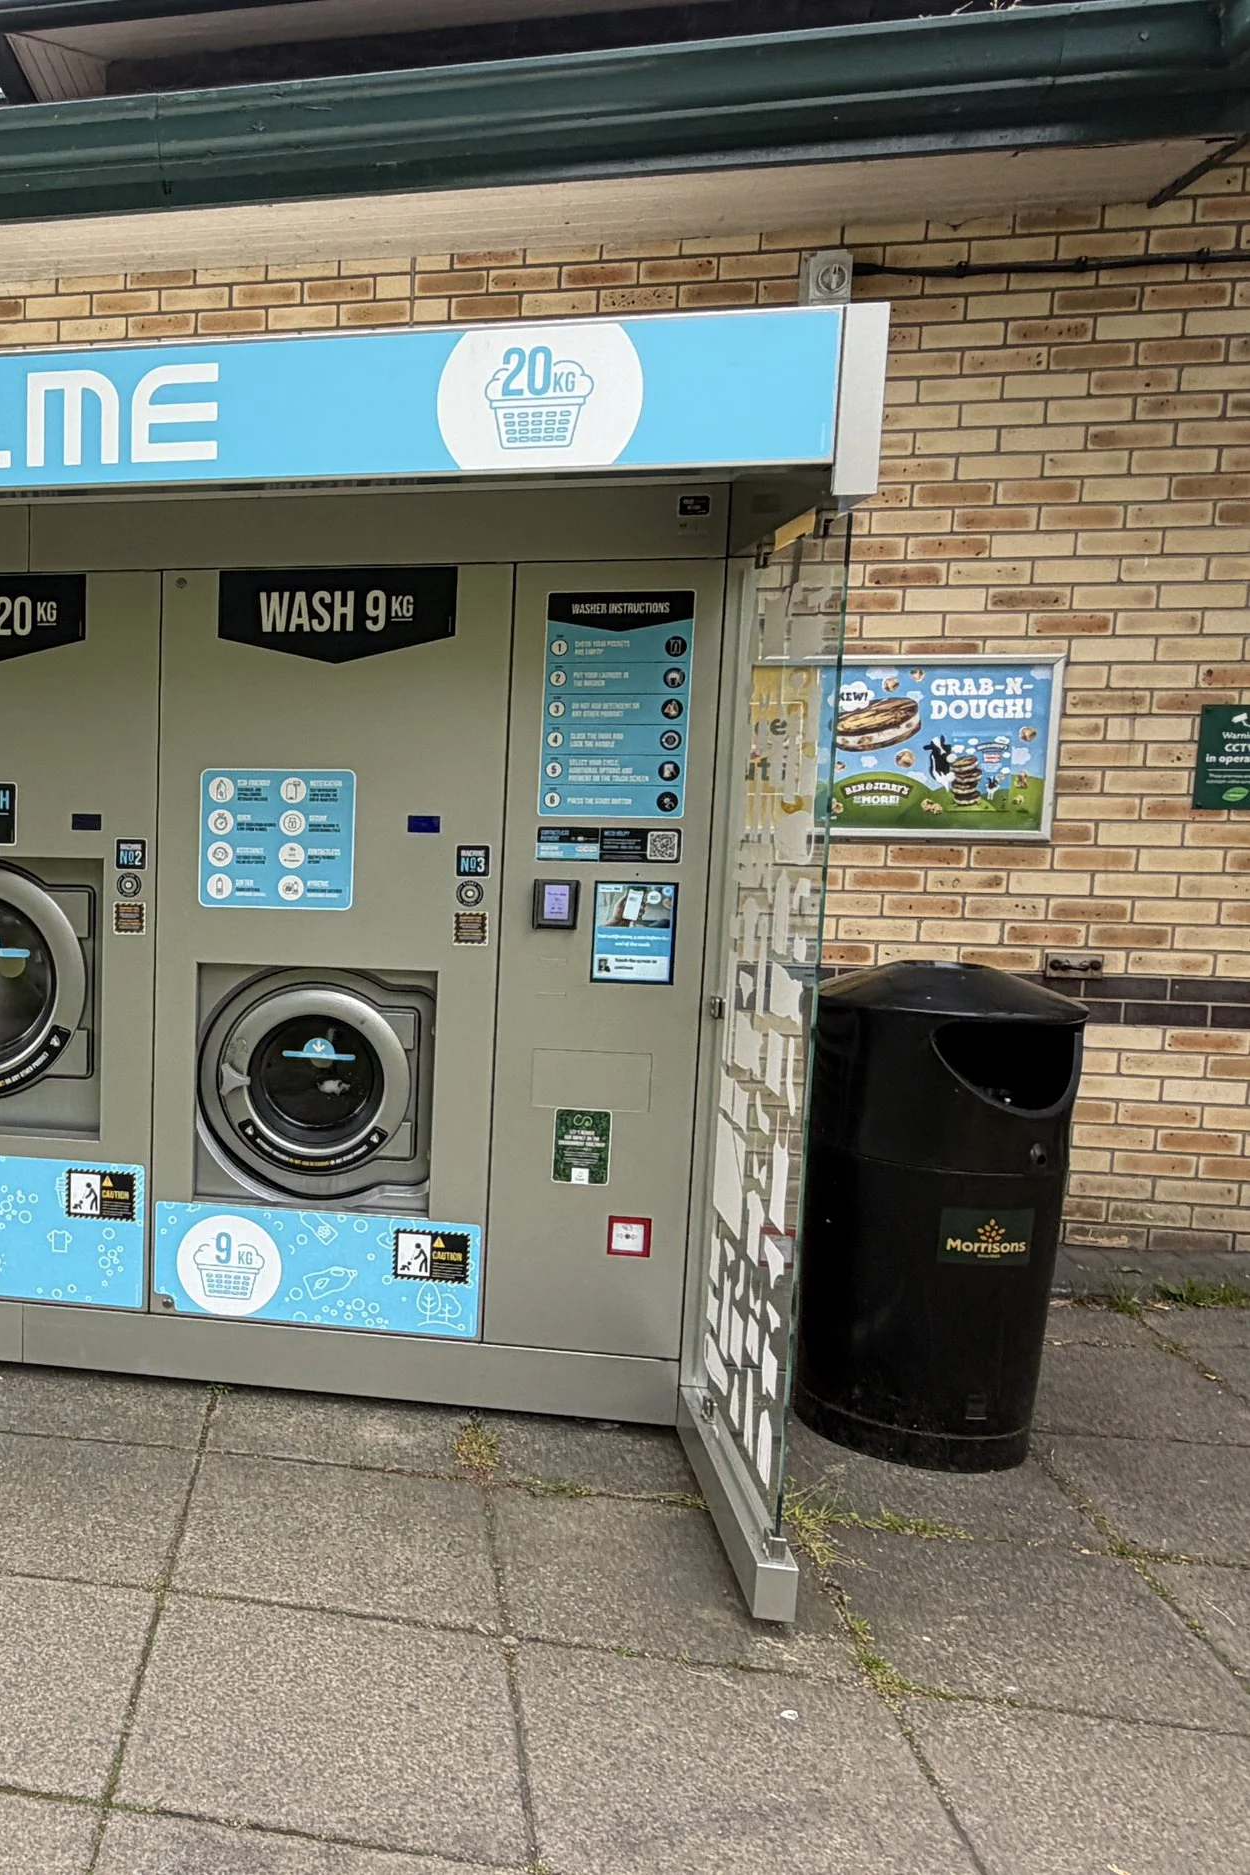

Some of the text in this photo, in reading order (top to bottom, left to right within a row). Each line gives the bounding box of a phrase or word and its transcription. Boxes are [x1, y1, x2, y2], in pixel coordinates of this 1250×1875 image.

[259, 589, 354, 633] WASH
[365, 588, 387, 632] 9
[572, 602, 670, 615] WASHER INSTRUCTIONS
[931, 677, 1033, 697] GRAB-N-
[930, 698, 1033, 720] DOUGH!
[1224, 743, 1250, 753] CCT
[1206, 754, 1216, 763] in
[844, 783, 865, 795] BEN
[873, 782, 910, 795] JERRY'S
[102, 1189, 129, 1200] CAUTION
[215, 1231, 253, 1266] 9 KG
[946, 1237, 1026, 1254] Morrisons
[432, 1250, 462, 1262] CAUTION
